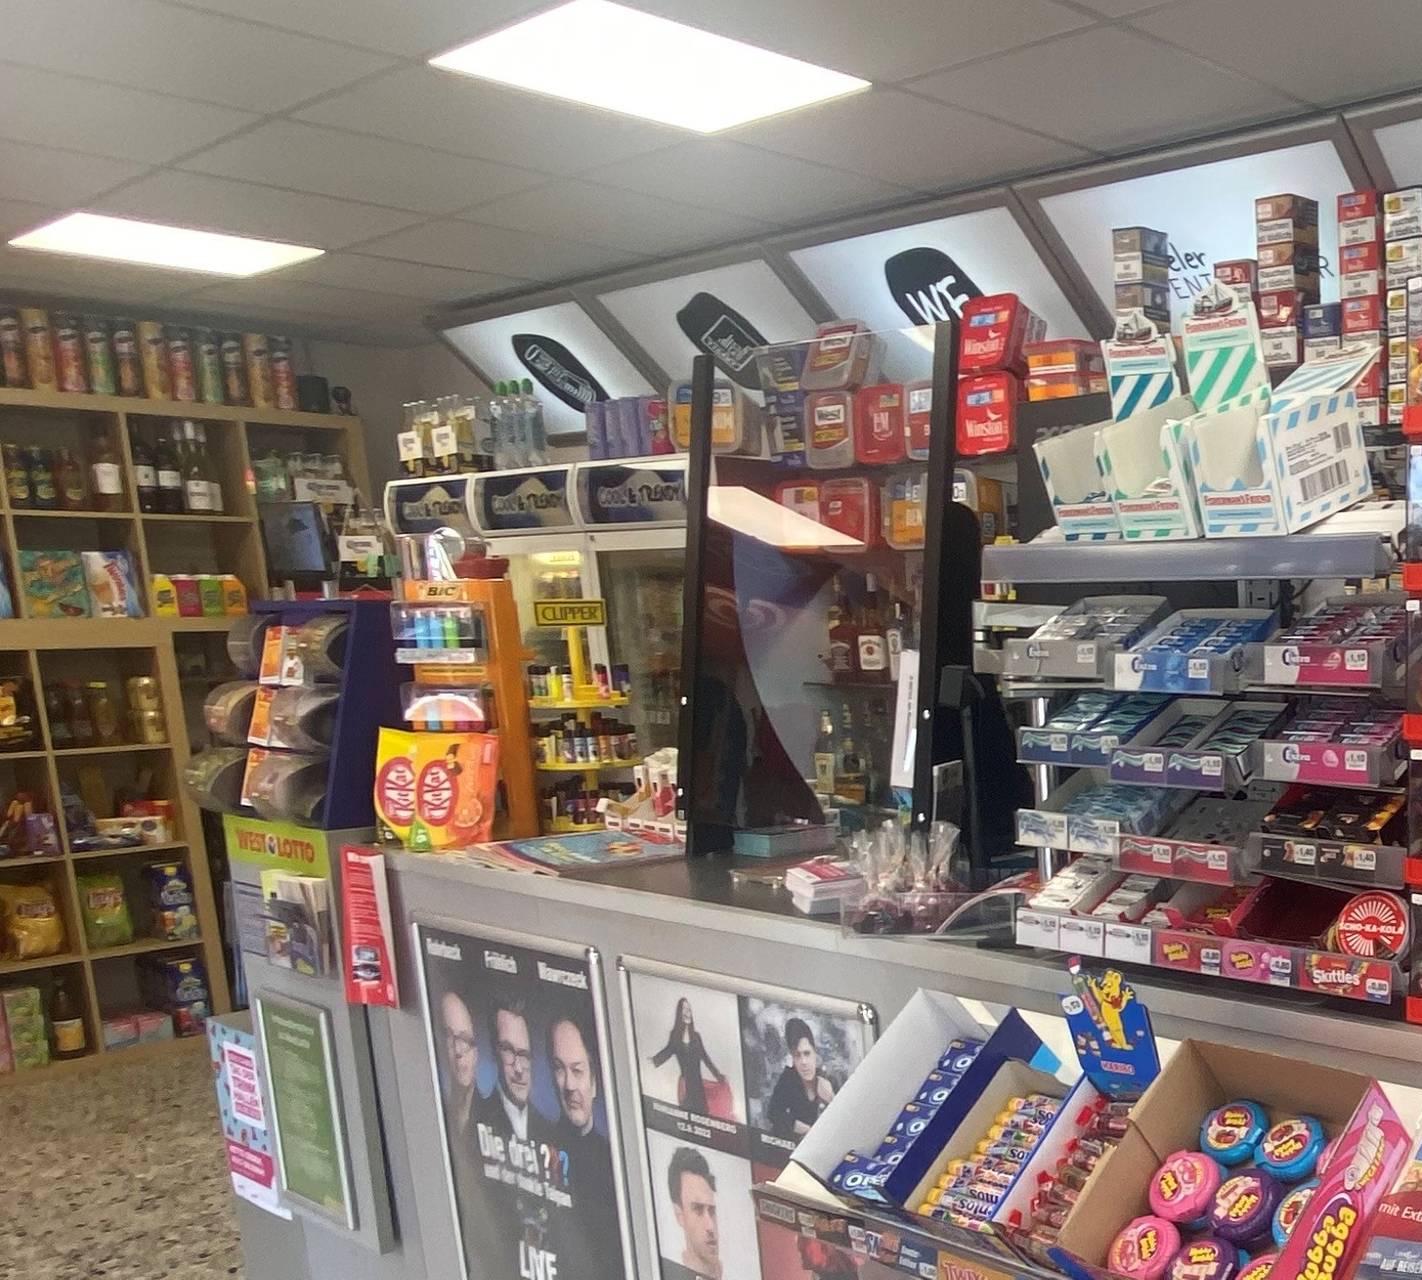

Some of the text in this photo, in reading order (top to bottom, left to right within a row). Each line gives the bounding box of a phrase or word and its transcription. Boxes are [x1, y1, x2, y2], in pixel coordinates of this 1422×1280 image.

[963, 336, 1004, 356] Winston
[965, 419, 1004, 438] Winston
[541, 604, 600, 622] CLIPPER
[237, 827, 316, 863] WEST LOTTO
[1312, 969, 1360, 986] Skittles
[477, 1122, 506, 1162] Die
[508, 1134, 540, 1176] drei
[1378, 1203, 1400, 1217] mit
[519, 1240, 558, 1280] LIVE
